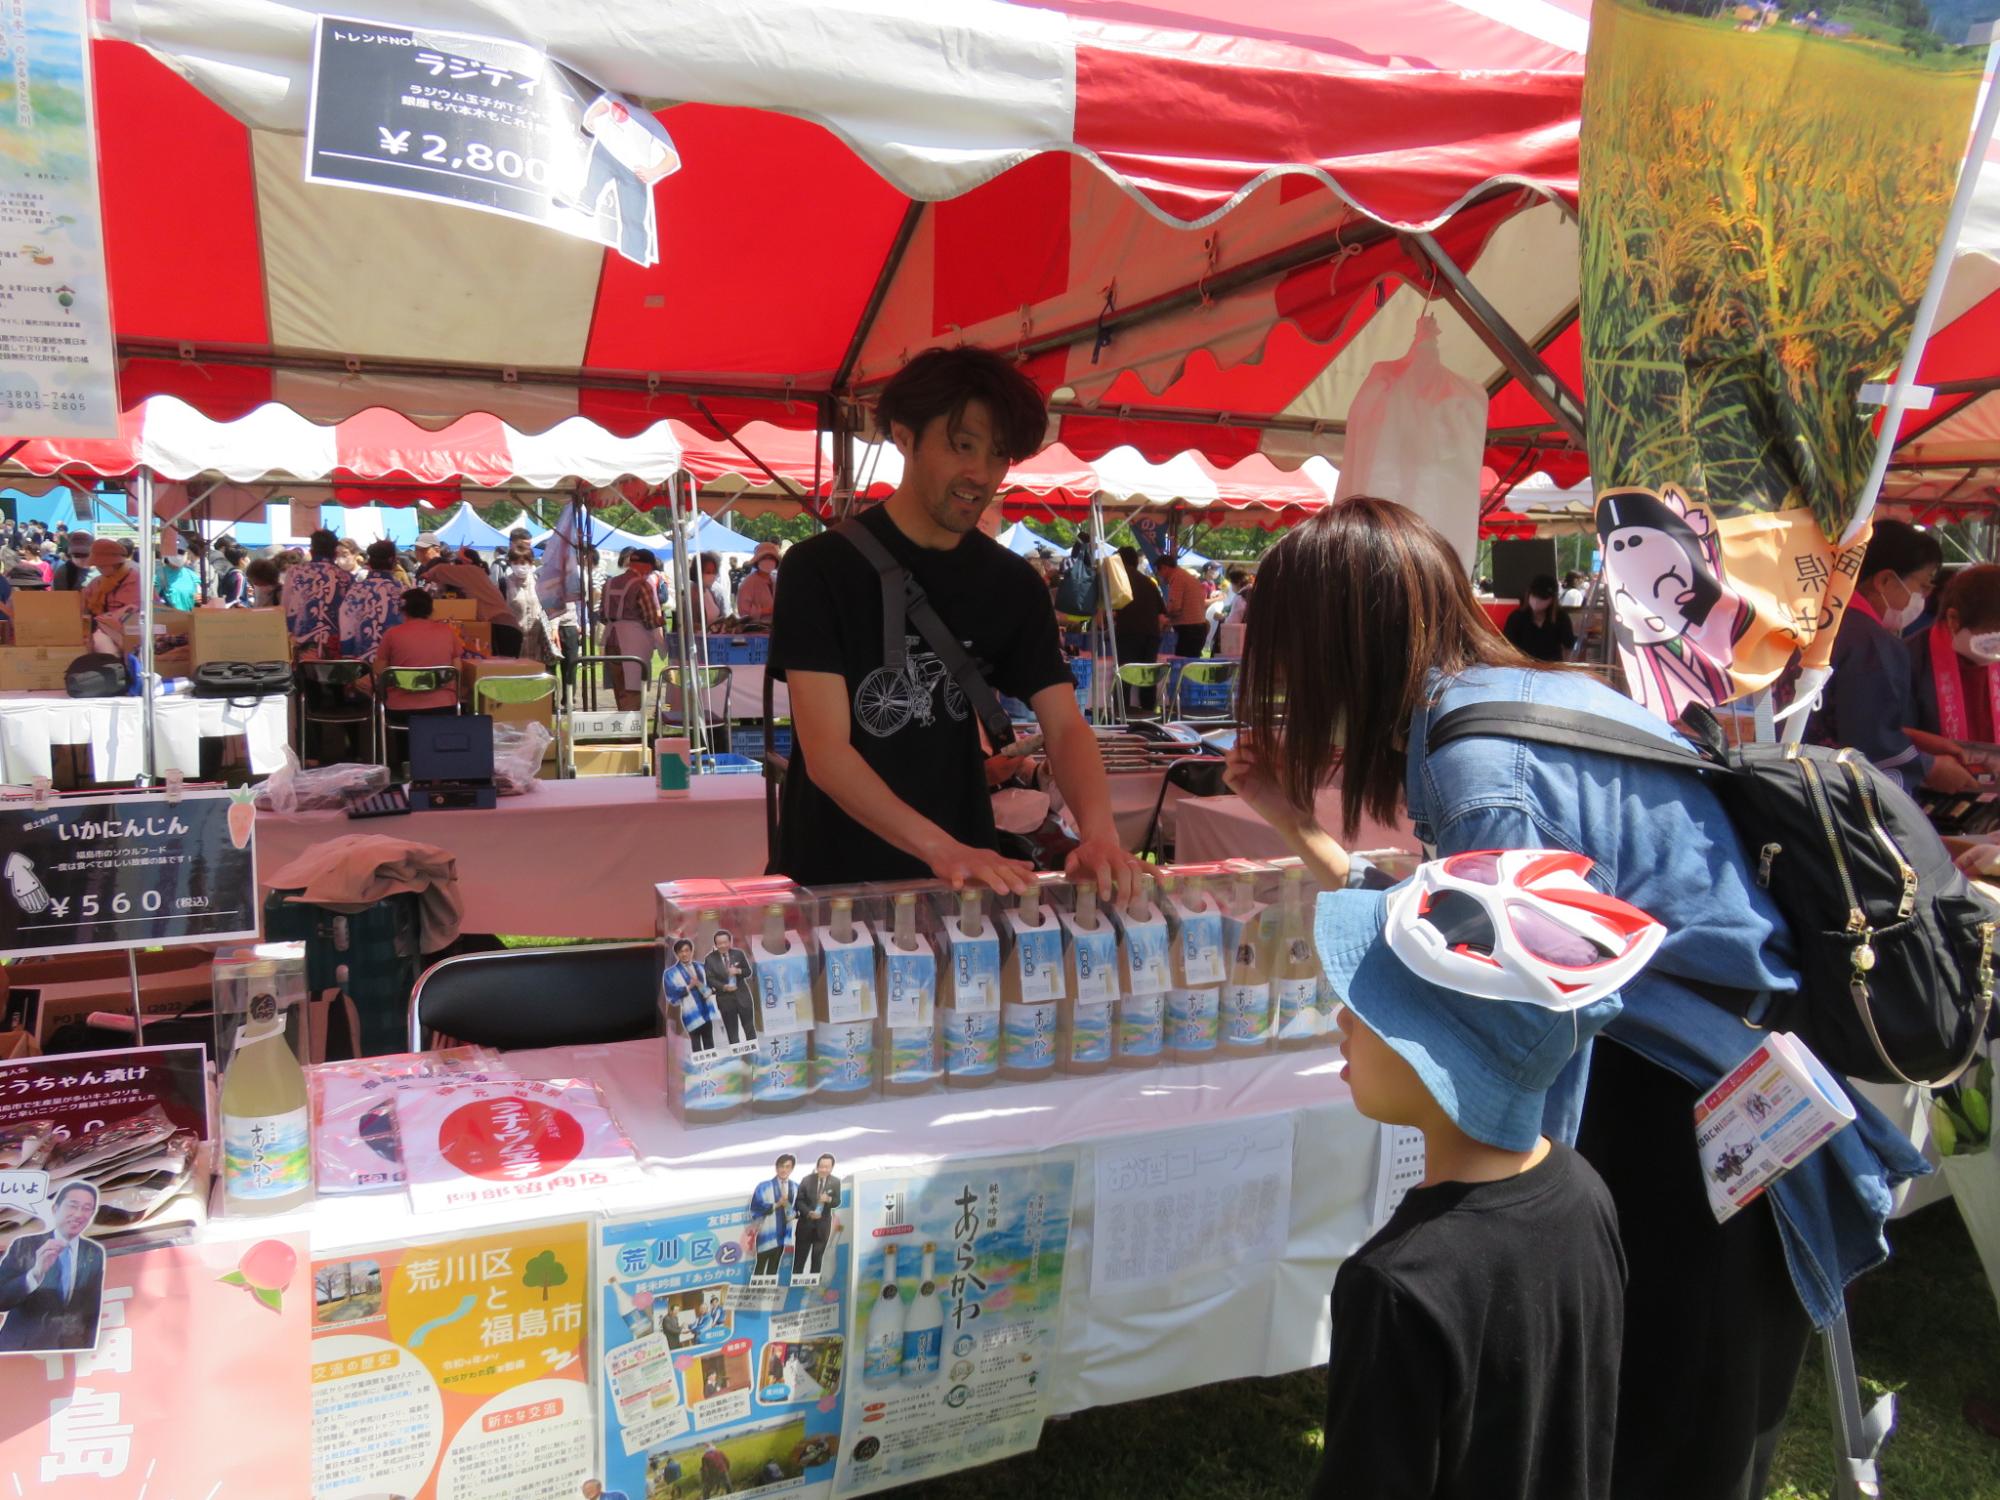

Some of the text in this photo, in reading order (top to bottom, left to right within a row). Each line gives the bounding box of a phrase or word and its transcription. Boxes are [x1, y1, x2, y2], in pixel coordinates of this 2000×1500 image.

[573, 719, 642, 733] 川口食品
[57, 815, 190, 841] いかにんじん
[250, 1123, 273, 1190] あらかわ
[405, 1247, 513, 1293] 荒川区
[623, 1237, 737, 1273] 荒川区と
[951, 1184, 986, 1330] あらかわ
[486, 1286, 508, 1310] と
[480, 1303, 584, 1348] 福島市
[313, 1354, 393, 1380] 交流の歴史
[488, 1402, 558, 1428] 新たな交流
